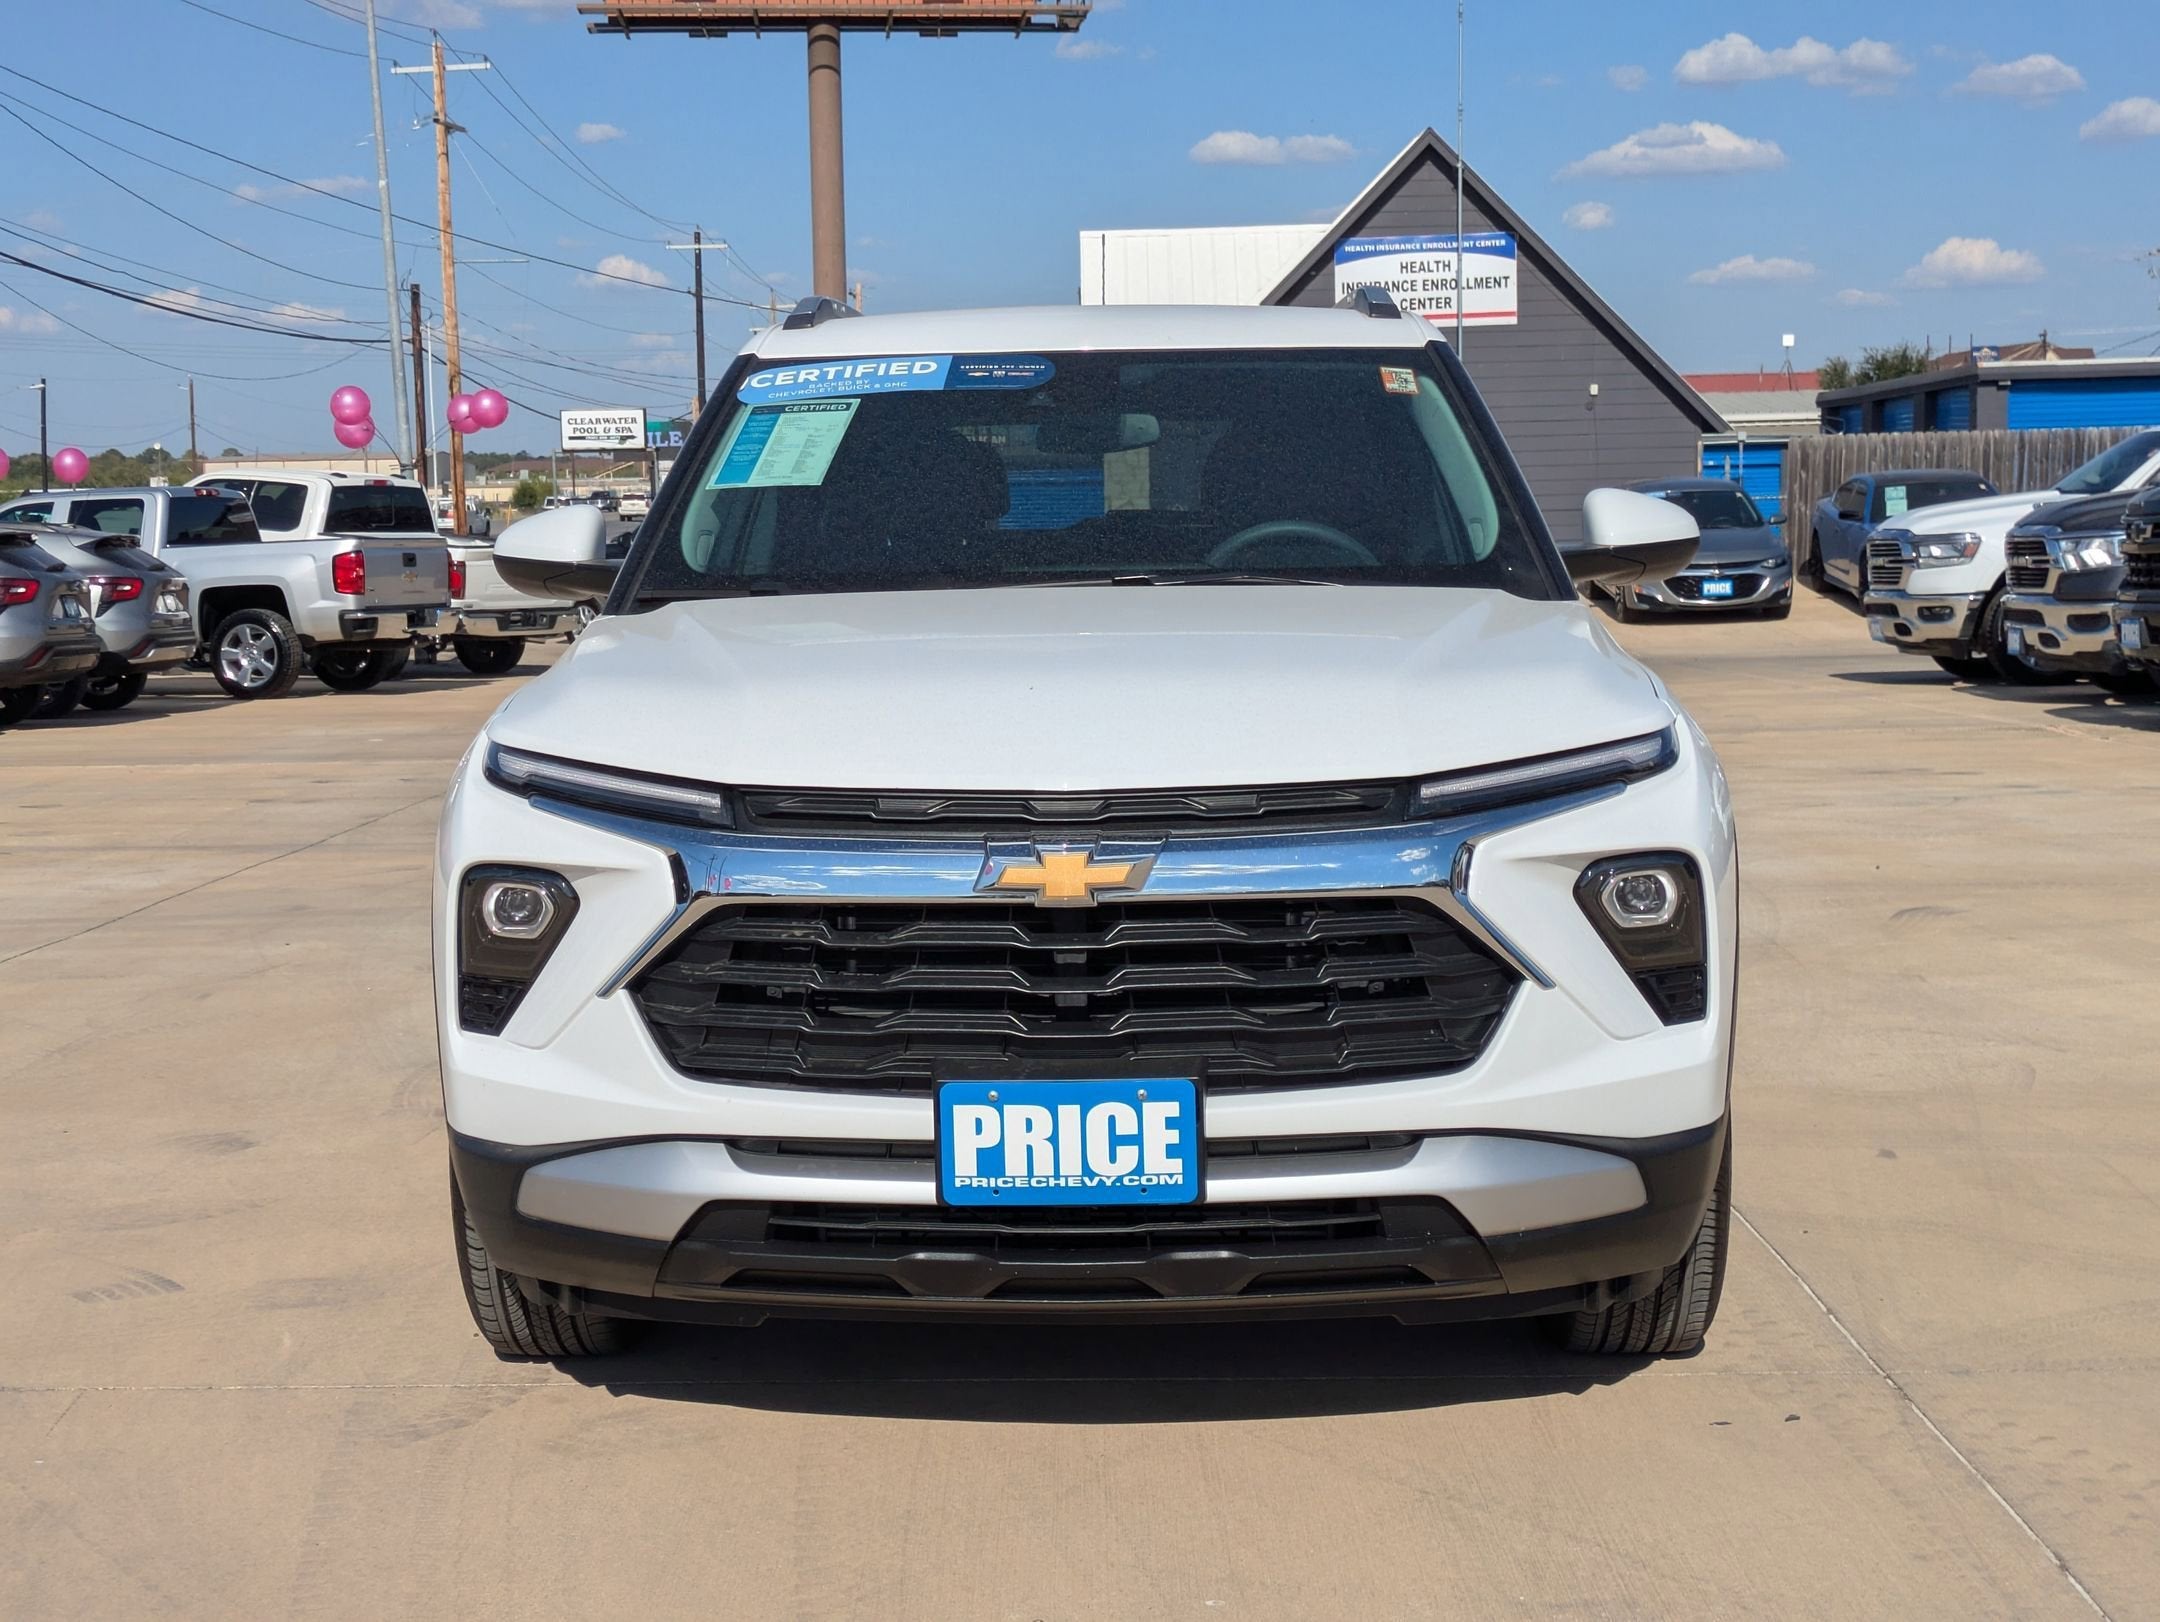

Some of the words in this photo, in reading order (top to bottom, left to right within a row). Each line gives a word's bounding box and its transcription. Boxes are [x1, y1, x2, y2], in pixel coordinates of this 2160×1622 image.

[1344, 244, 1375, 253] HEALTH
[1376, 243, 1421, 251] INSURANCE
[1422, 241, 1474, 250] ENROLLMNT
[1475, 239, 1506, 248] CENTER
[1400, 260, 1451, 274] HEALTH
[1400, 296, 1452, 311] CENTER
[751, 361, 938, 388] CERTIFIED
[808, 380, 853, 389] BACKED
[838, 384, 871, 392] BUICK
[784, 404, 847, 412] CERTIFIED
[567, 417, 638, 425] CLEARWATER
[572, 426, 600, 434] POOL
[603, 426, 611, 434] &
[614, 426, 633, 434] SPA
[1703, 583, 1732, 594] PRICE
[952, 1101, 1184, 1177] PRICE
[954, 1174, 1184, 1188] PRICECHEVY.COM
